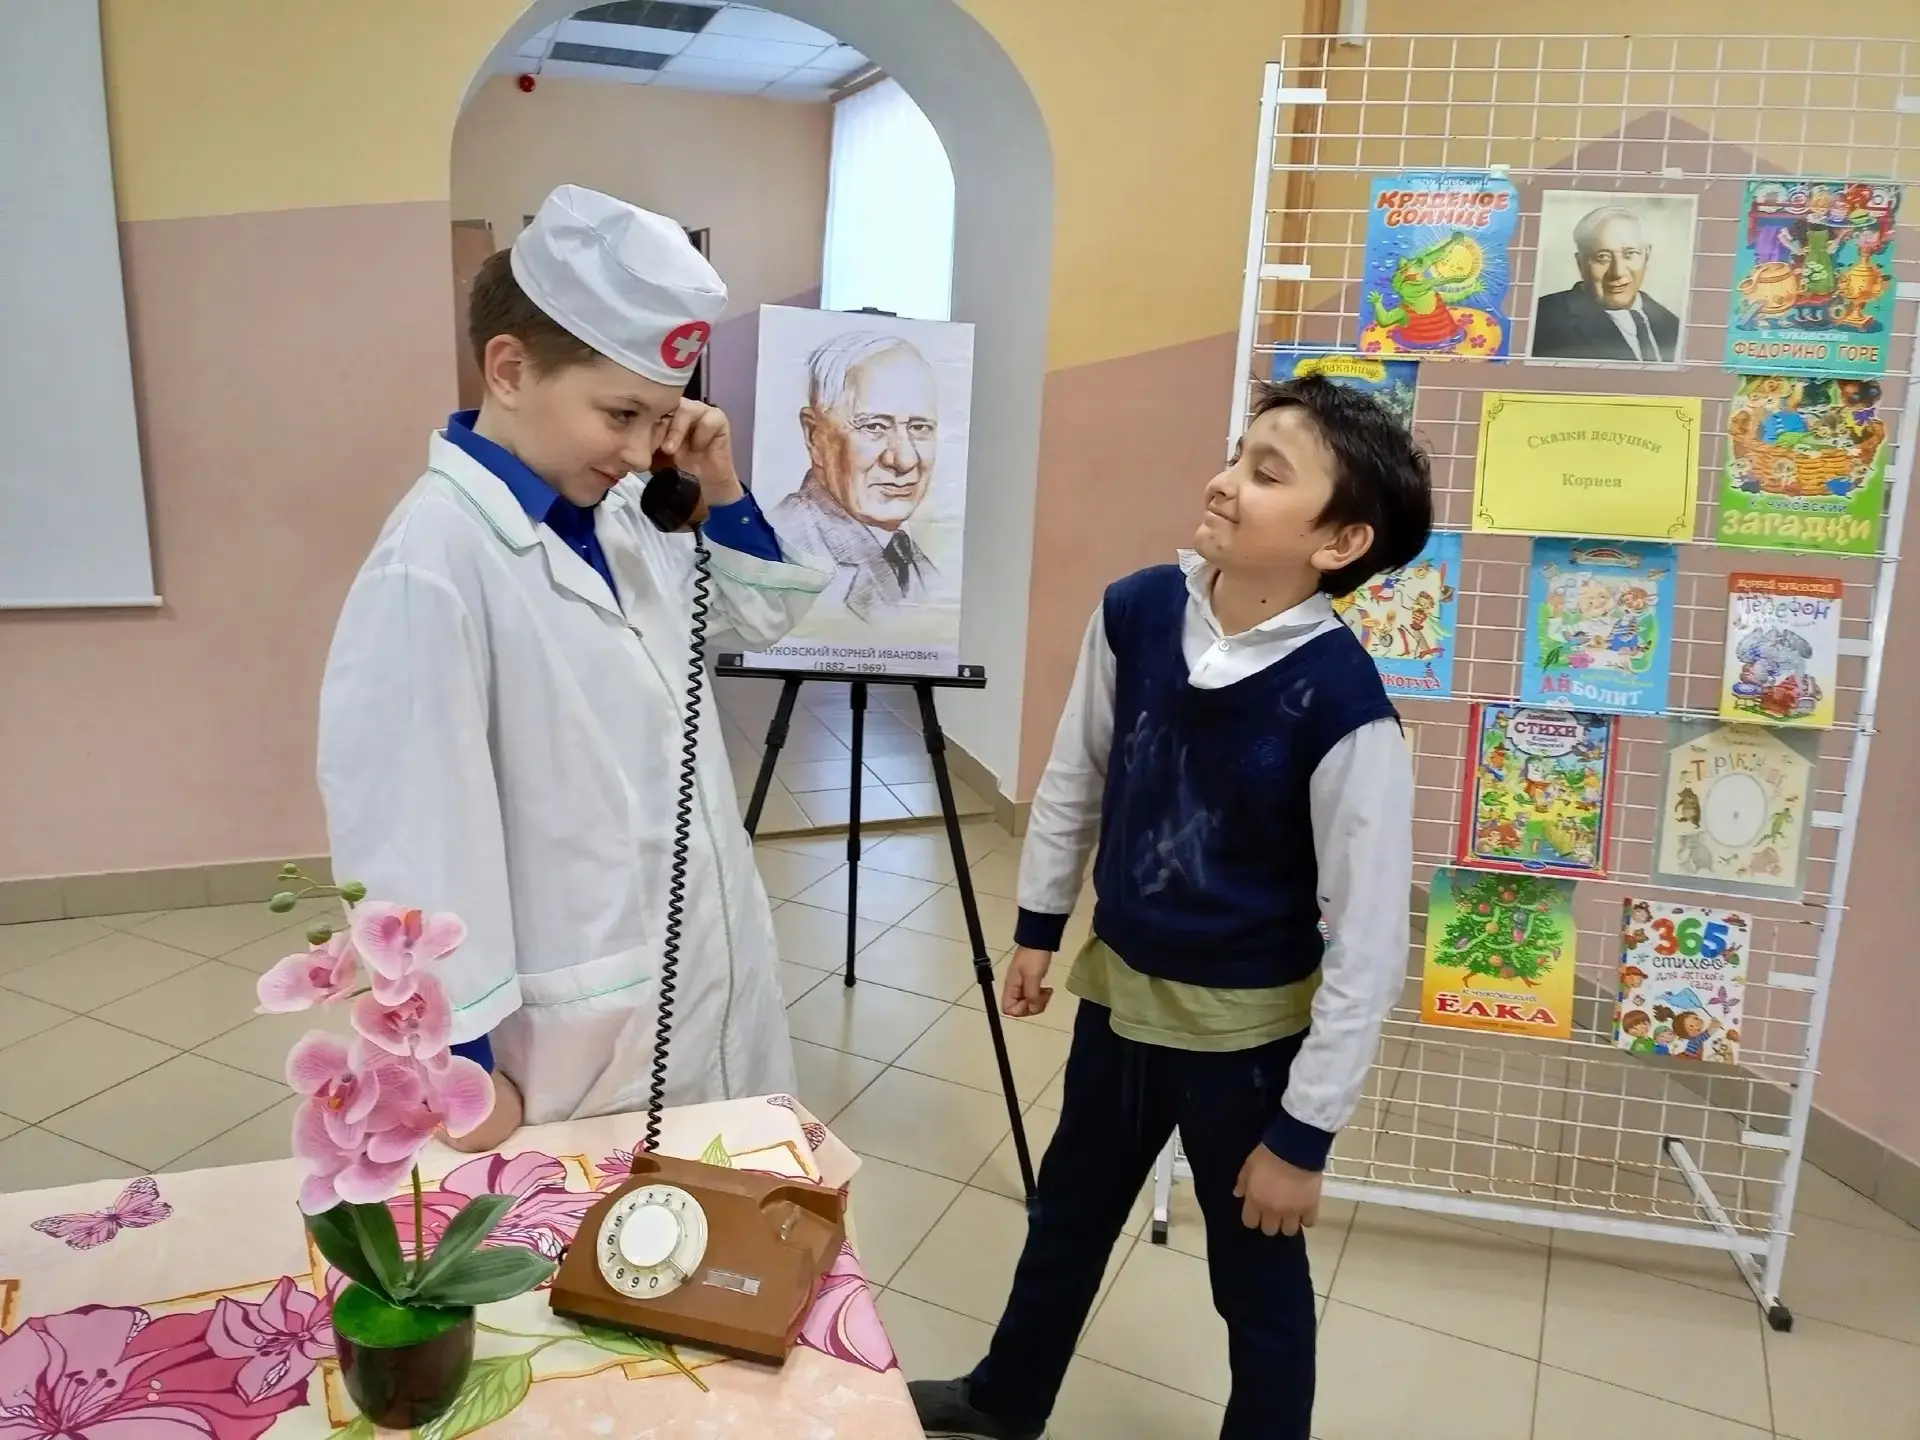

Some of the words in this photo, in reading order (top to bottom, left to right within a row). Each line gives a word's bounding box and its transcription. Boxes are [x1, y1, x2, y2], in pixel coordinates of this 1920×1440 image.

[1376, 190, 1510, 211] КРАДЕНОЕ
[1386, 208, 1491, 227] СОЛНЦЕ
[1733, 341, 1828, 361] ФЕДОРИНО
[1836, 344, 1880, 362] ГОРЕ
[1526, 429, 1587, 450] Сказки
[1590, 429, 1662, 455] дедушки
[1561, 473, 1623, 489] Корнея
[832, 646, 877, 659] КОРНЕЙ
[878, 650, 939, 661] ИВАНОВИЧ
[1539, 673, 1643, 707] АЙБОЛИТ
[1514, 721, 1578, 738] СТИХИ
[1651, 917, 1730, 959] 365
[1435, 993, 1558, 1026] ЁЛКА
[606, 1233, 617, 1246] 6
[607, 1252, 617, 1263] 7
[615, 1267, 625, 1280] 8
[631, 1276, 640, 1289] 9
[649, 1276, 659, 1289] 0
